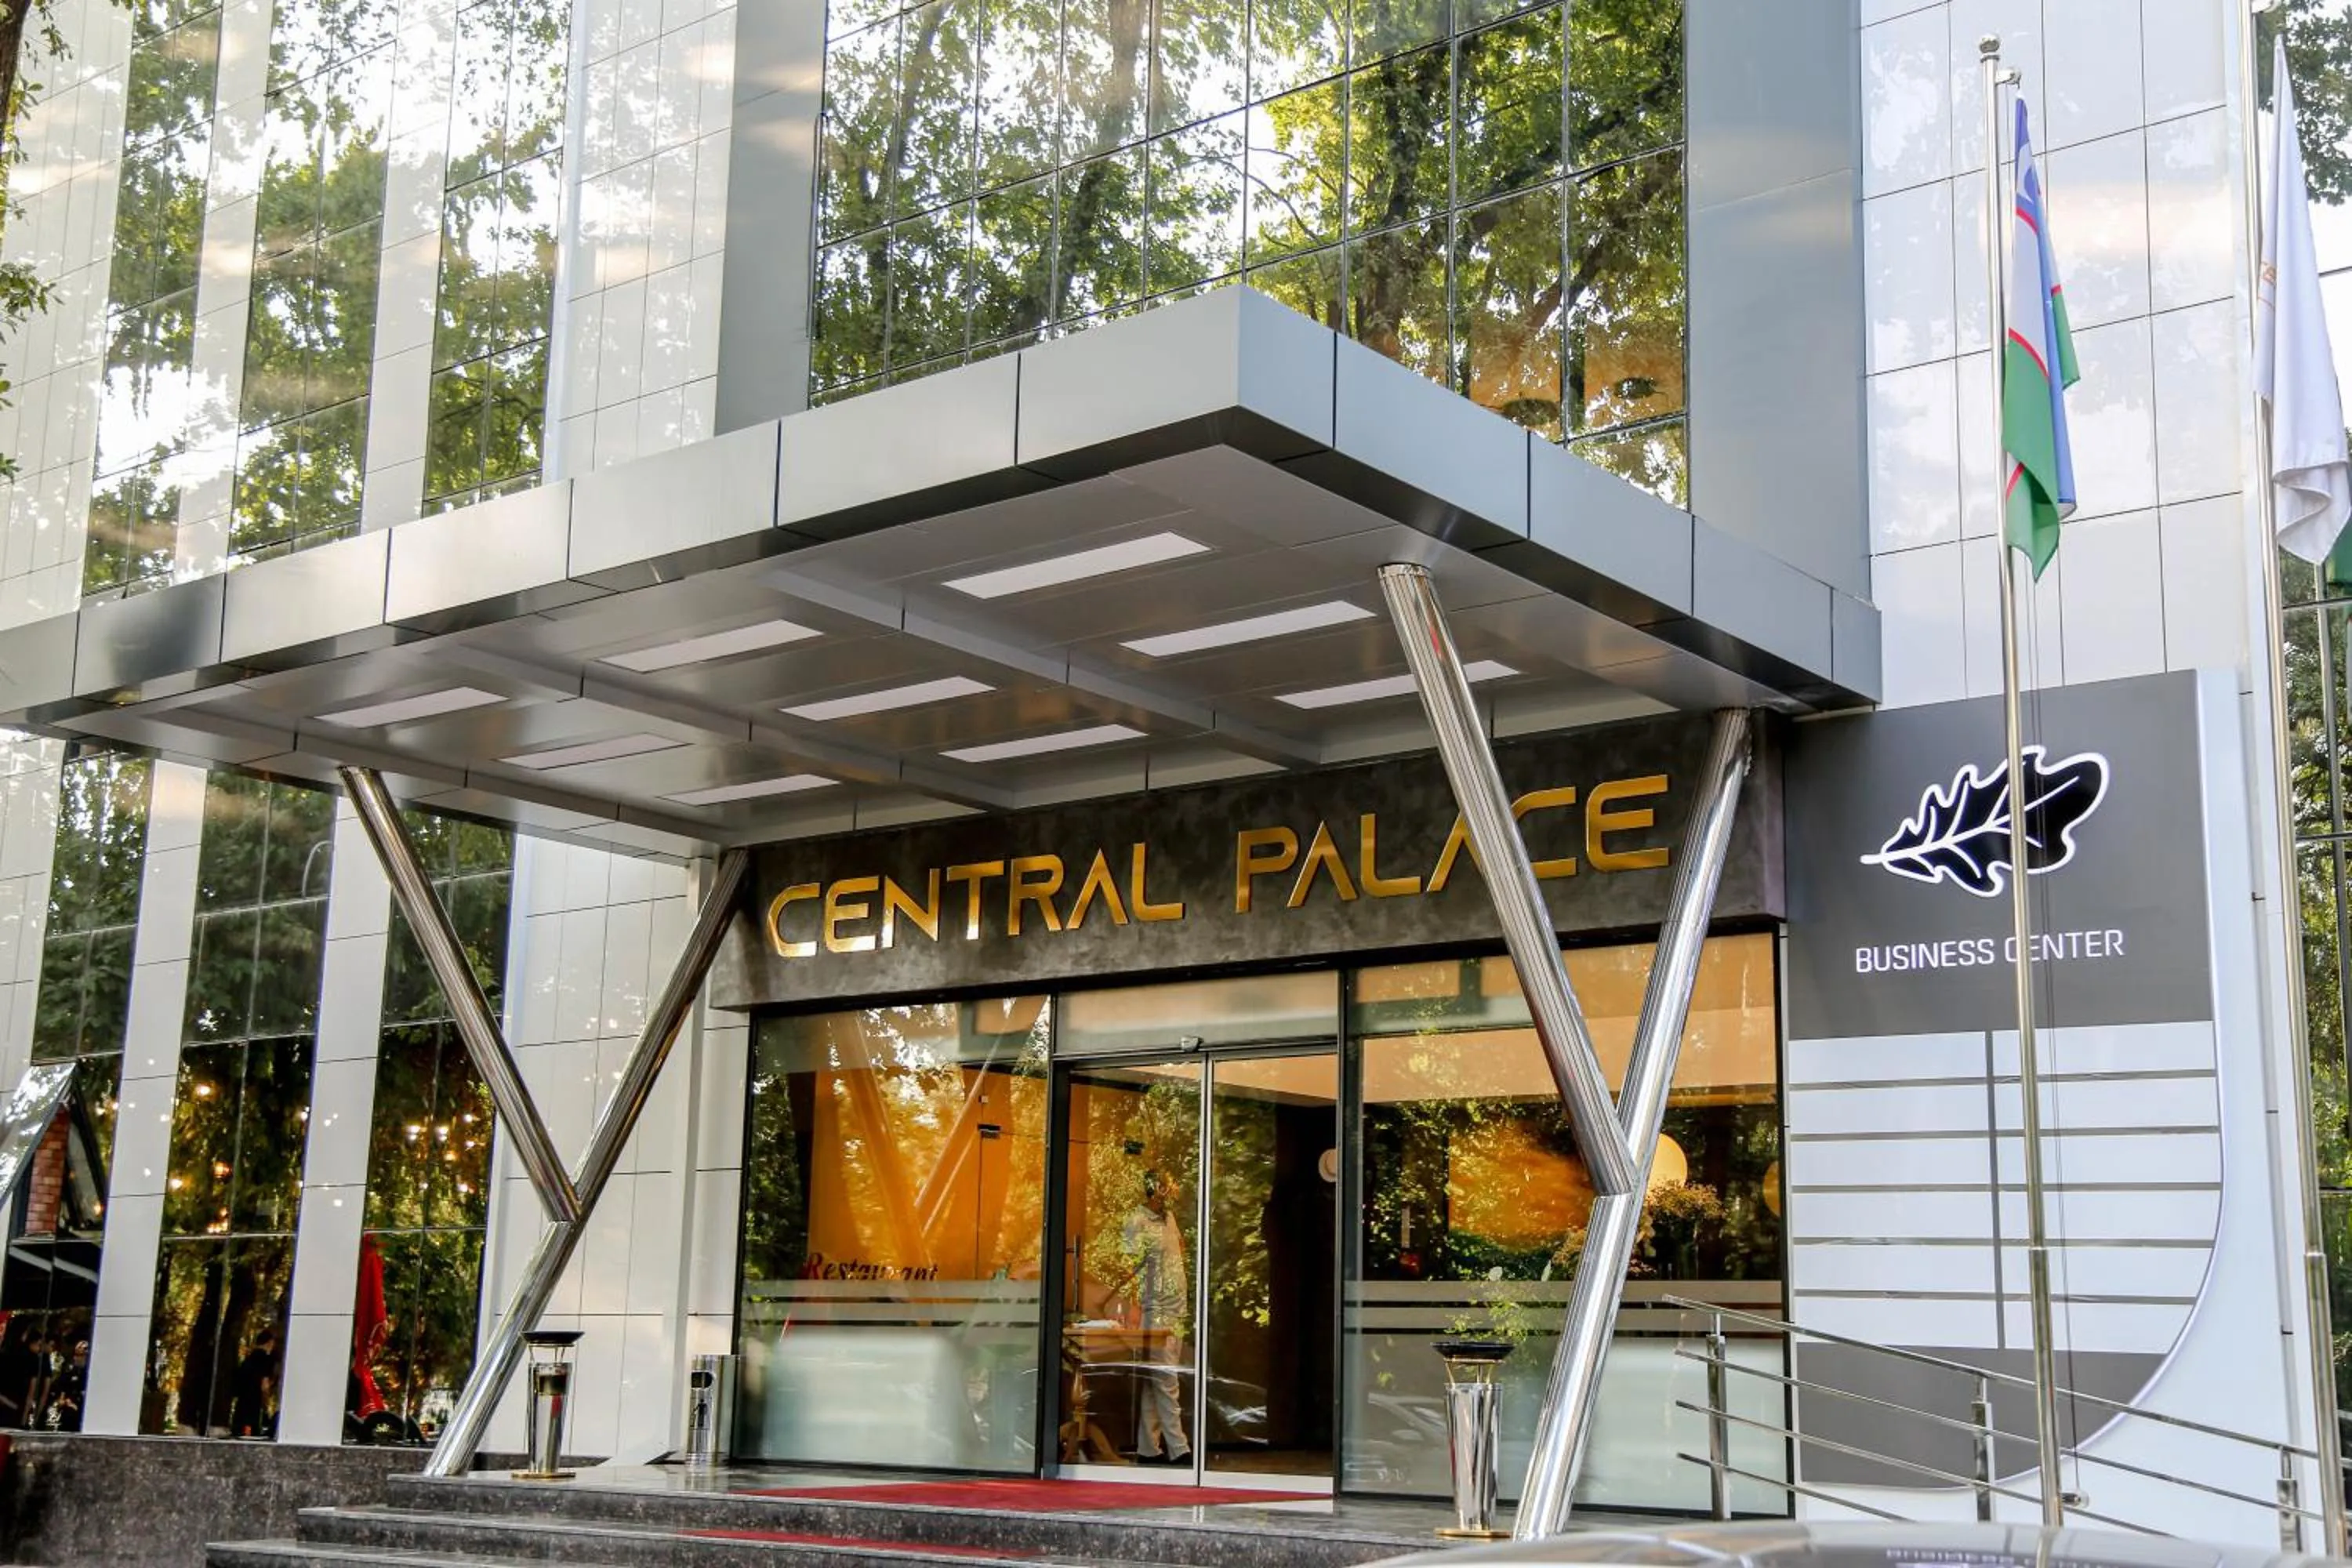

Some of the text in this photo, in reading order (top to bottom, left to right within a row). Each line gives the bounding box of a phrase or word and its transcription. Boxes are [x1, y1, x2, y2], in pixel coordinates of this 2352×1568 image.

[768, 774, 1669, 958] CENTRAL PALACE
[1855, 928, 2126, 974] BUSINESS CENTER
[800, 1252, 938, 1280] Restauant
